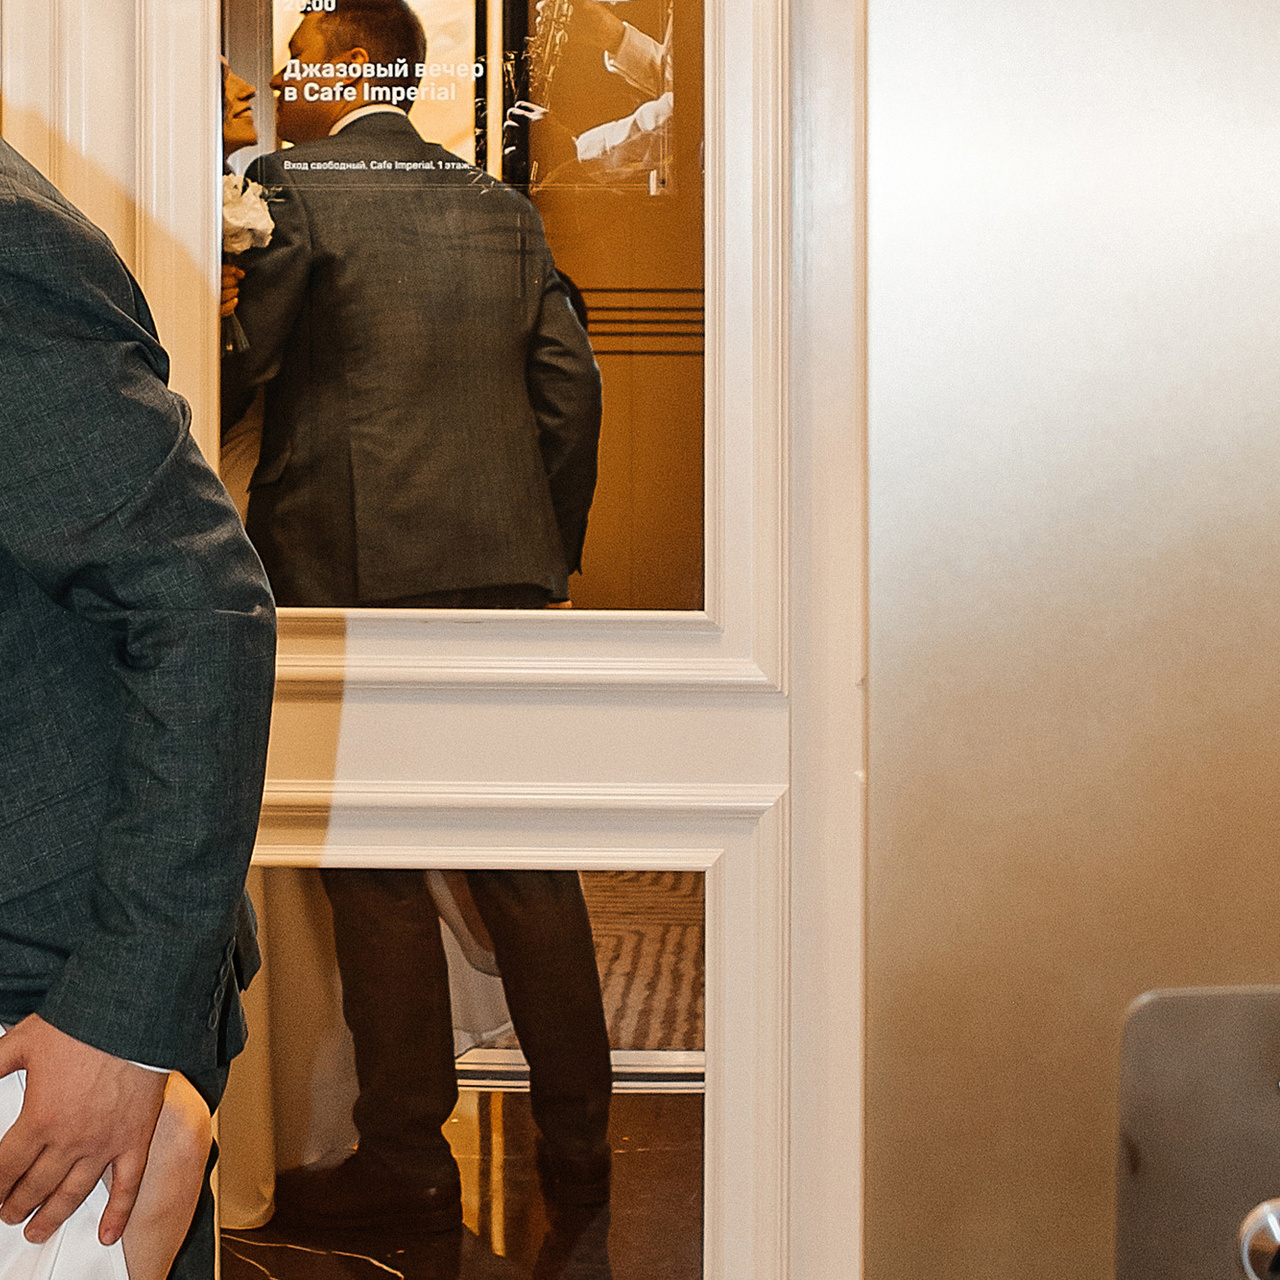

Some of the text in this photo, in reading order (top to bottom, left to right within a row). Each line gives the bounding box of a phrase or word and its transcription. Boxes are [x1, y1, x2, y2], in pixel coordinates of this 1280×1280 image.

[283, 58, 485, 81] Джазовый вечер
[284, 81, 456, 104] в Cafe Imperial
[283, 160, 309, 170] Вход
[370, 160, 393, 170] Cafe
[437, 160, 443, 170] 1
